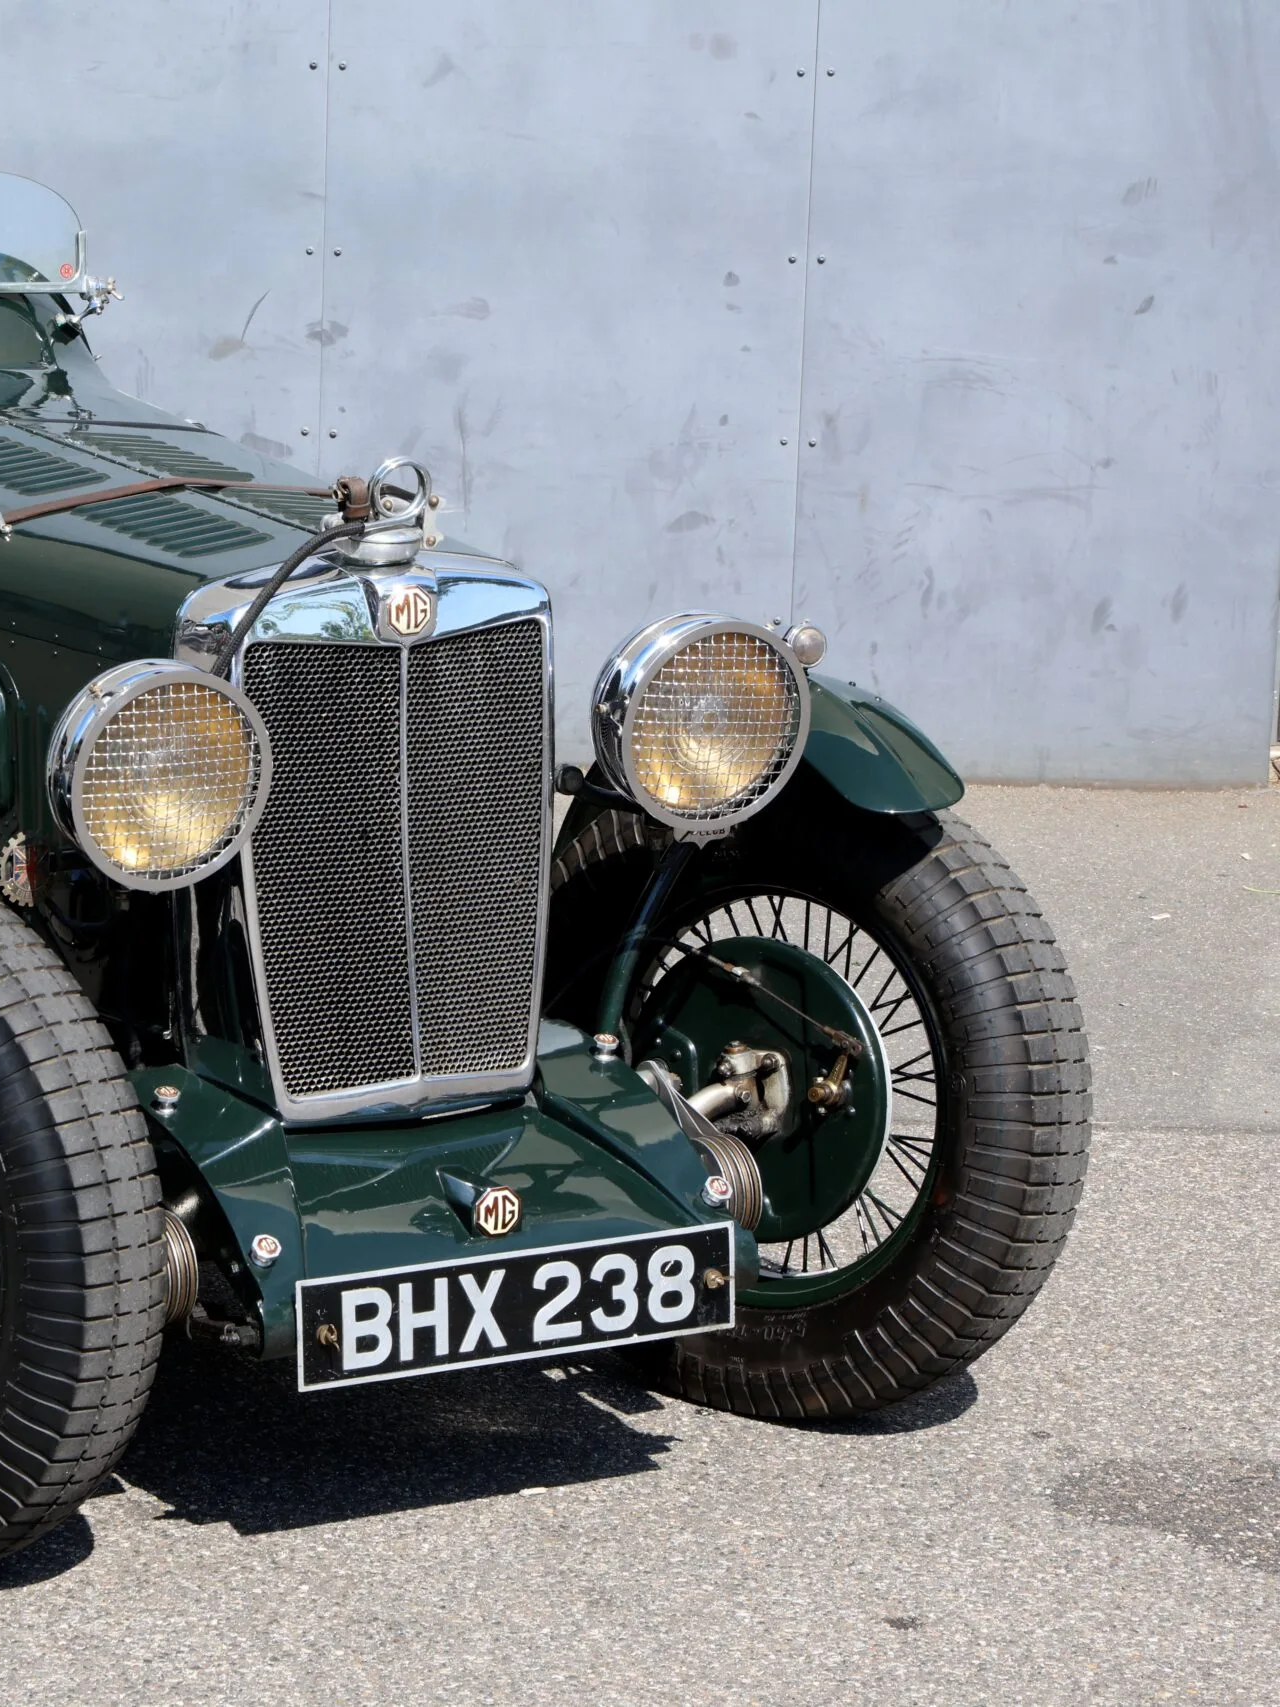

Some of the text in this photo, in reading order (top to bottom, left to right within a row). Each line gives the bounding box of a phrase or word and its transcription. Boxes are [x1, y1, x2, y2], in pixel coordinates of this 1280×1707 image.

[395, 592, 428, 630] MG
[483, 1194, 516, 1231] MG
[340, 1244, 696, 1371] BHX 238
